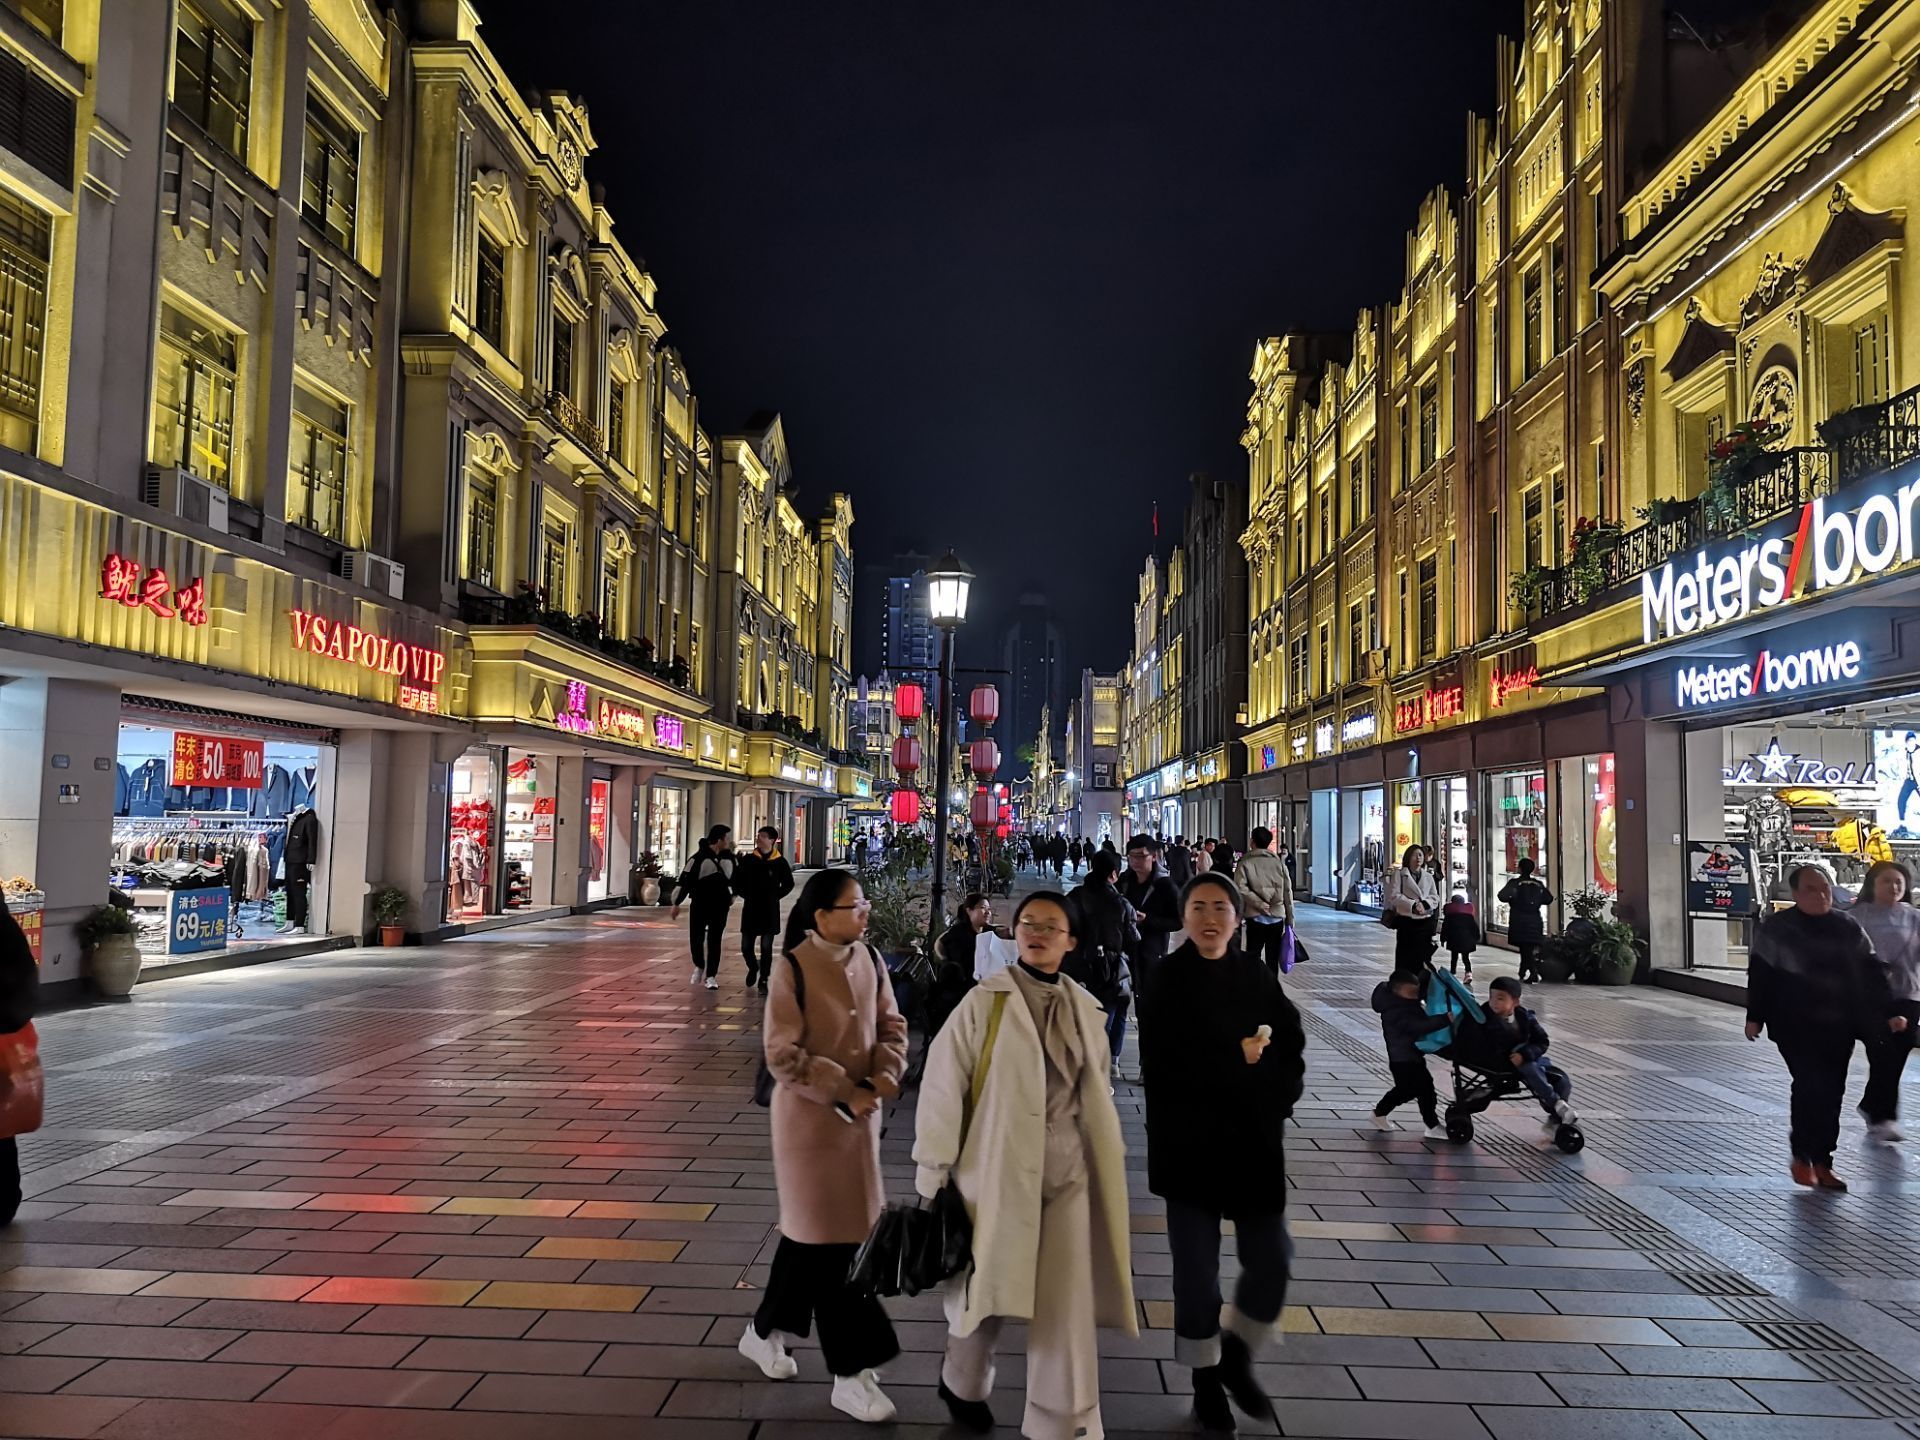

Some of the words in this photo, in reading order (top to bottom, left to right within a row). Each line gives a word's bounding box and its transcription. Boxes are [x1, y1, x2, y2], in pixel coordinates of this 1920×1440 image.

[1677, 640, 1860, 707] Meters/bonwe
[175, 735, 197, 757] 年末
[175, 758, 195, 780] 清仓
[1715, 889, 1732, 898] 799
[1715, 898, 1732, 906] 399
